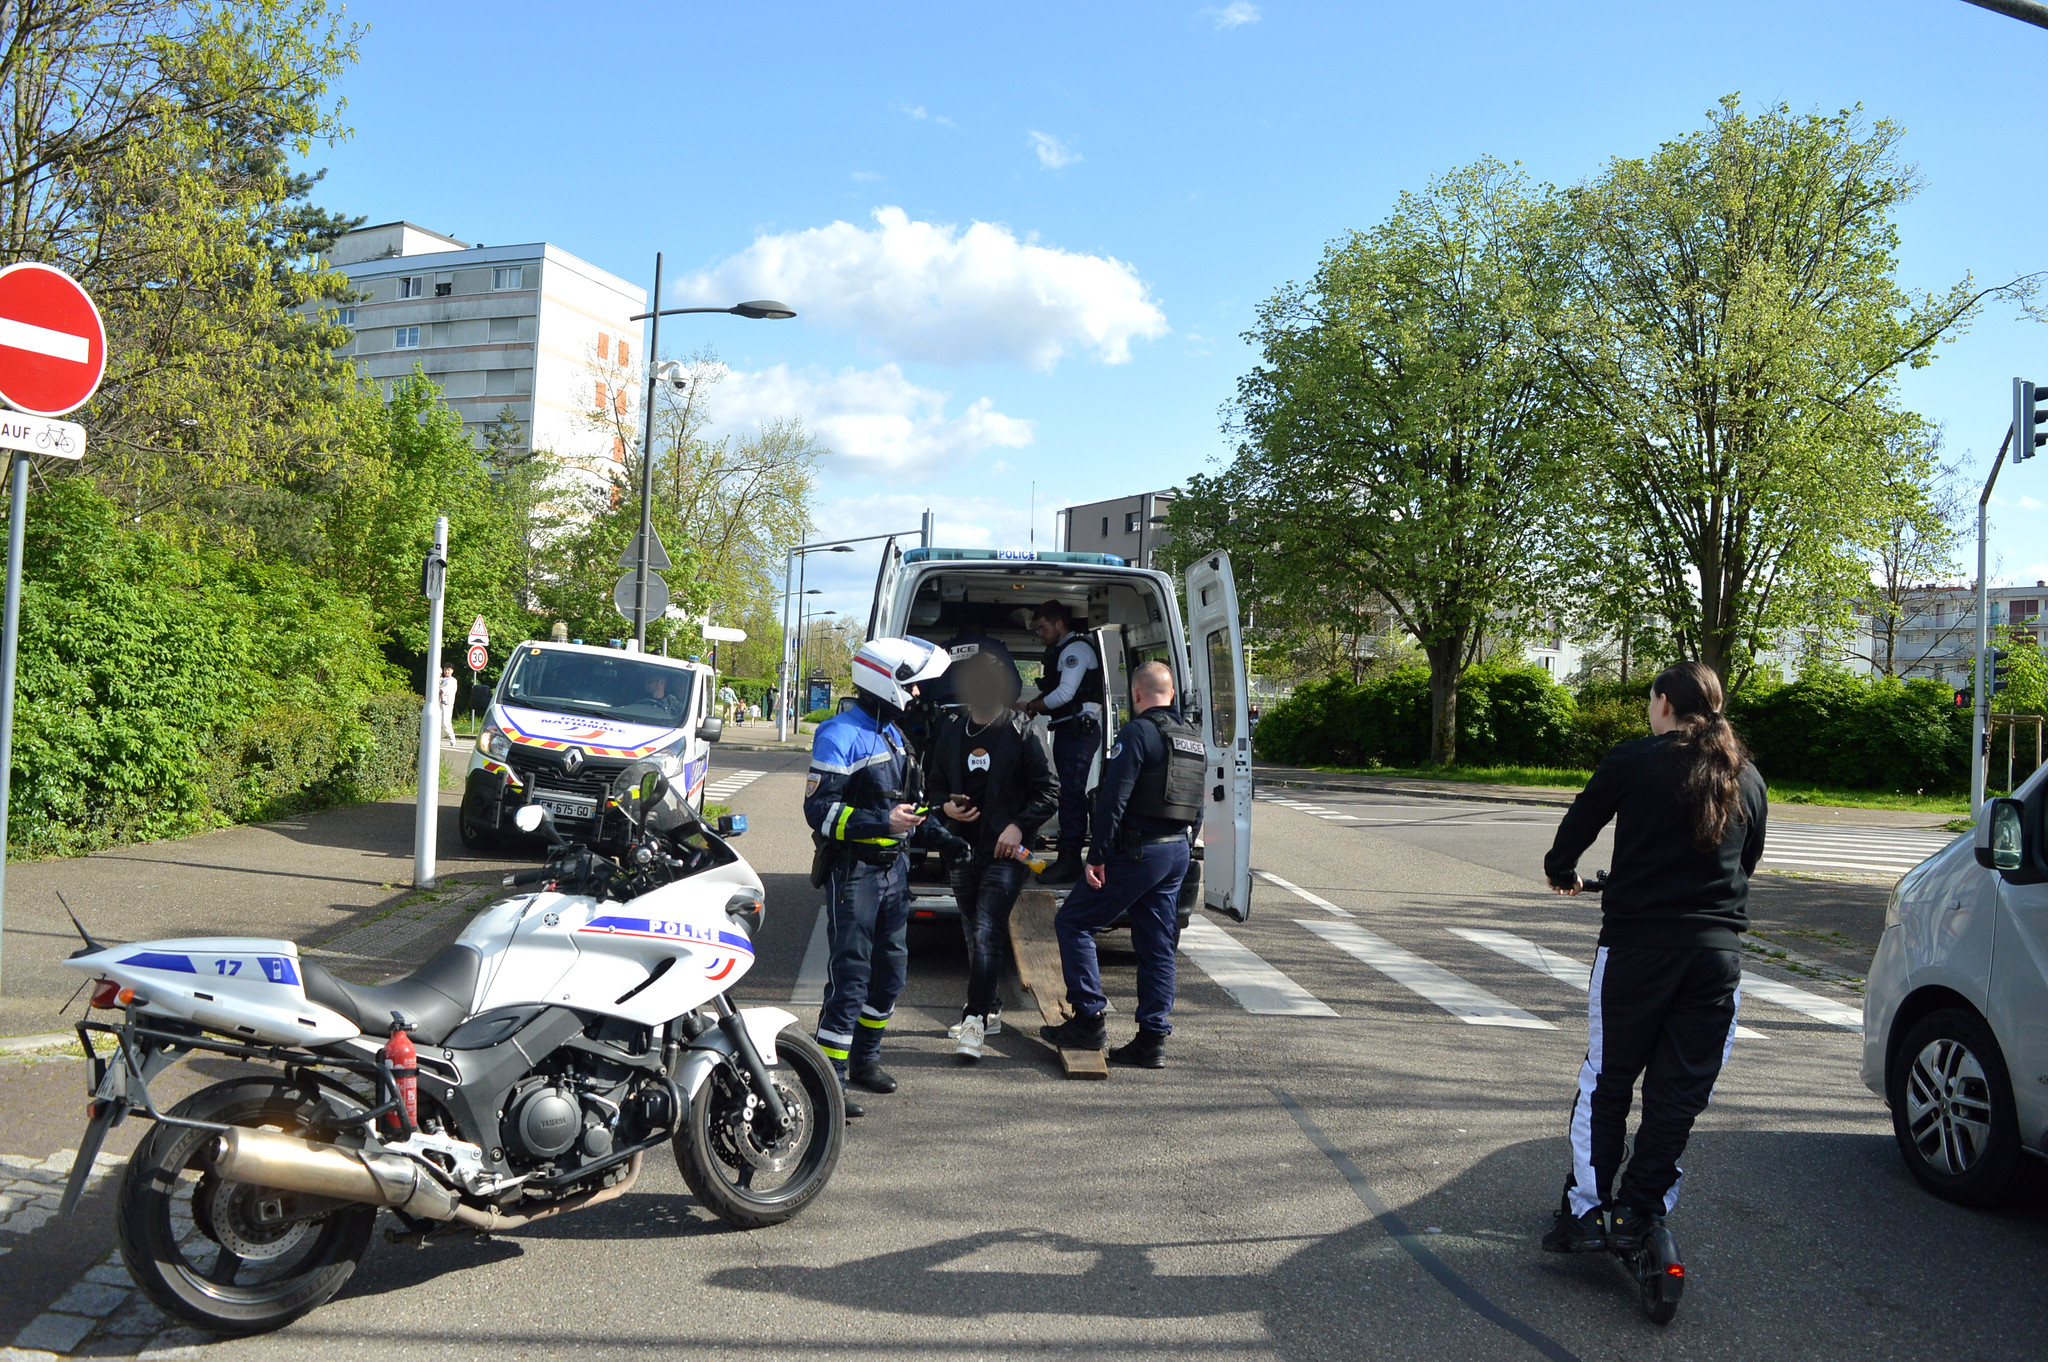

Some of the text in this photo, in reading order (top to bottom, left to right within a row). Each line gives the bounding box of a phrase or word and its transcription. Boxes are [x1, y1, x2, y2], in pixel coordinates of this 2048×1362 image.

[1, 423, 31, 439] AUF
[998, 550, 1036, 560] POLICE
[950, 645, 976, 656] LICE
[472, 652, 484, 663] 30
[541, 718, 626, 734] NATIONALE
[560, 716, 612, 726] POLICE
[1175, 739, 1203, 753] POLICE
[648, 920, 719, 943] POLICE
[215, 959, 243, 976] 17
[541, 1117, 567, 1130] YAMAHA
